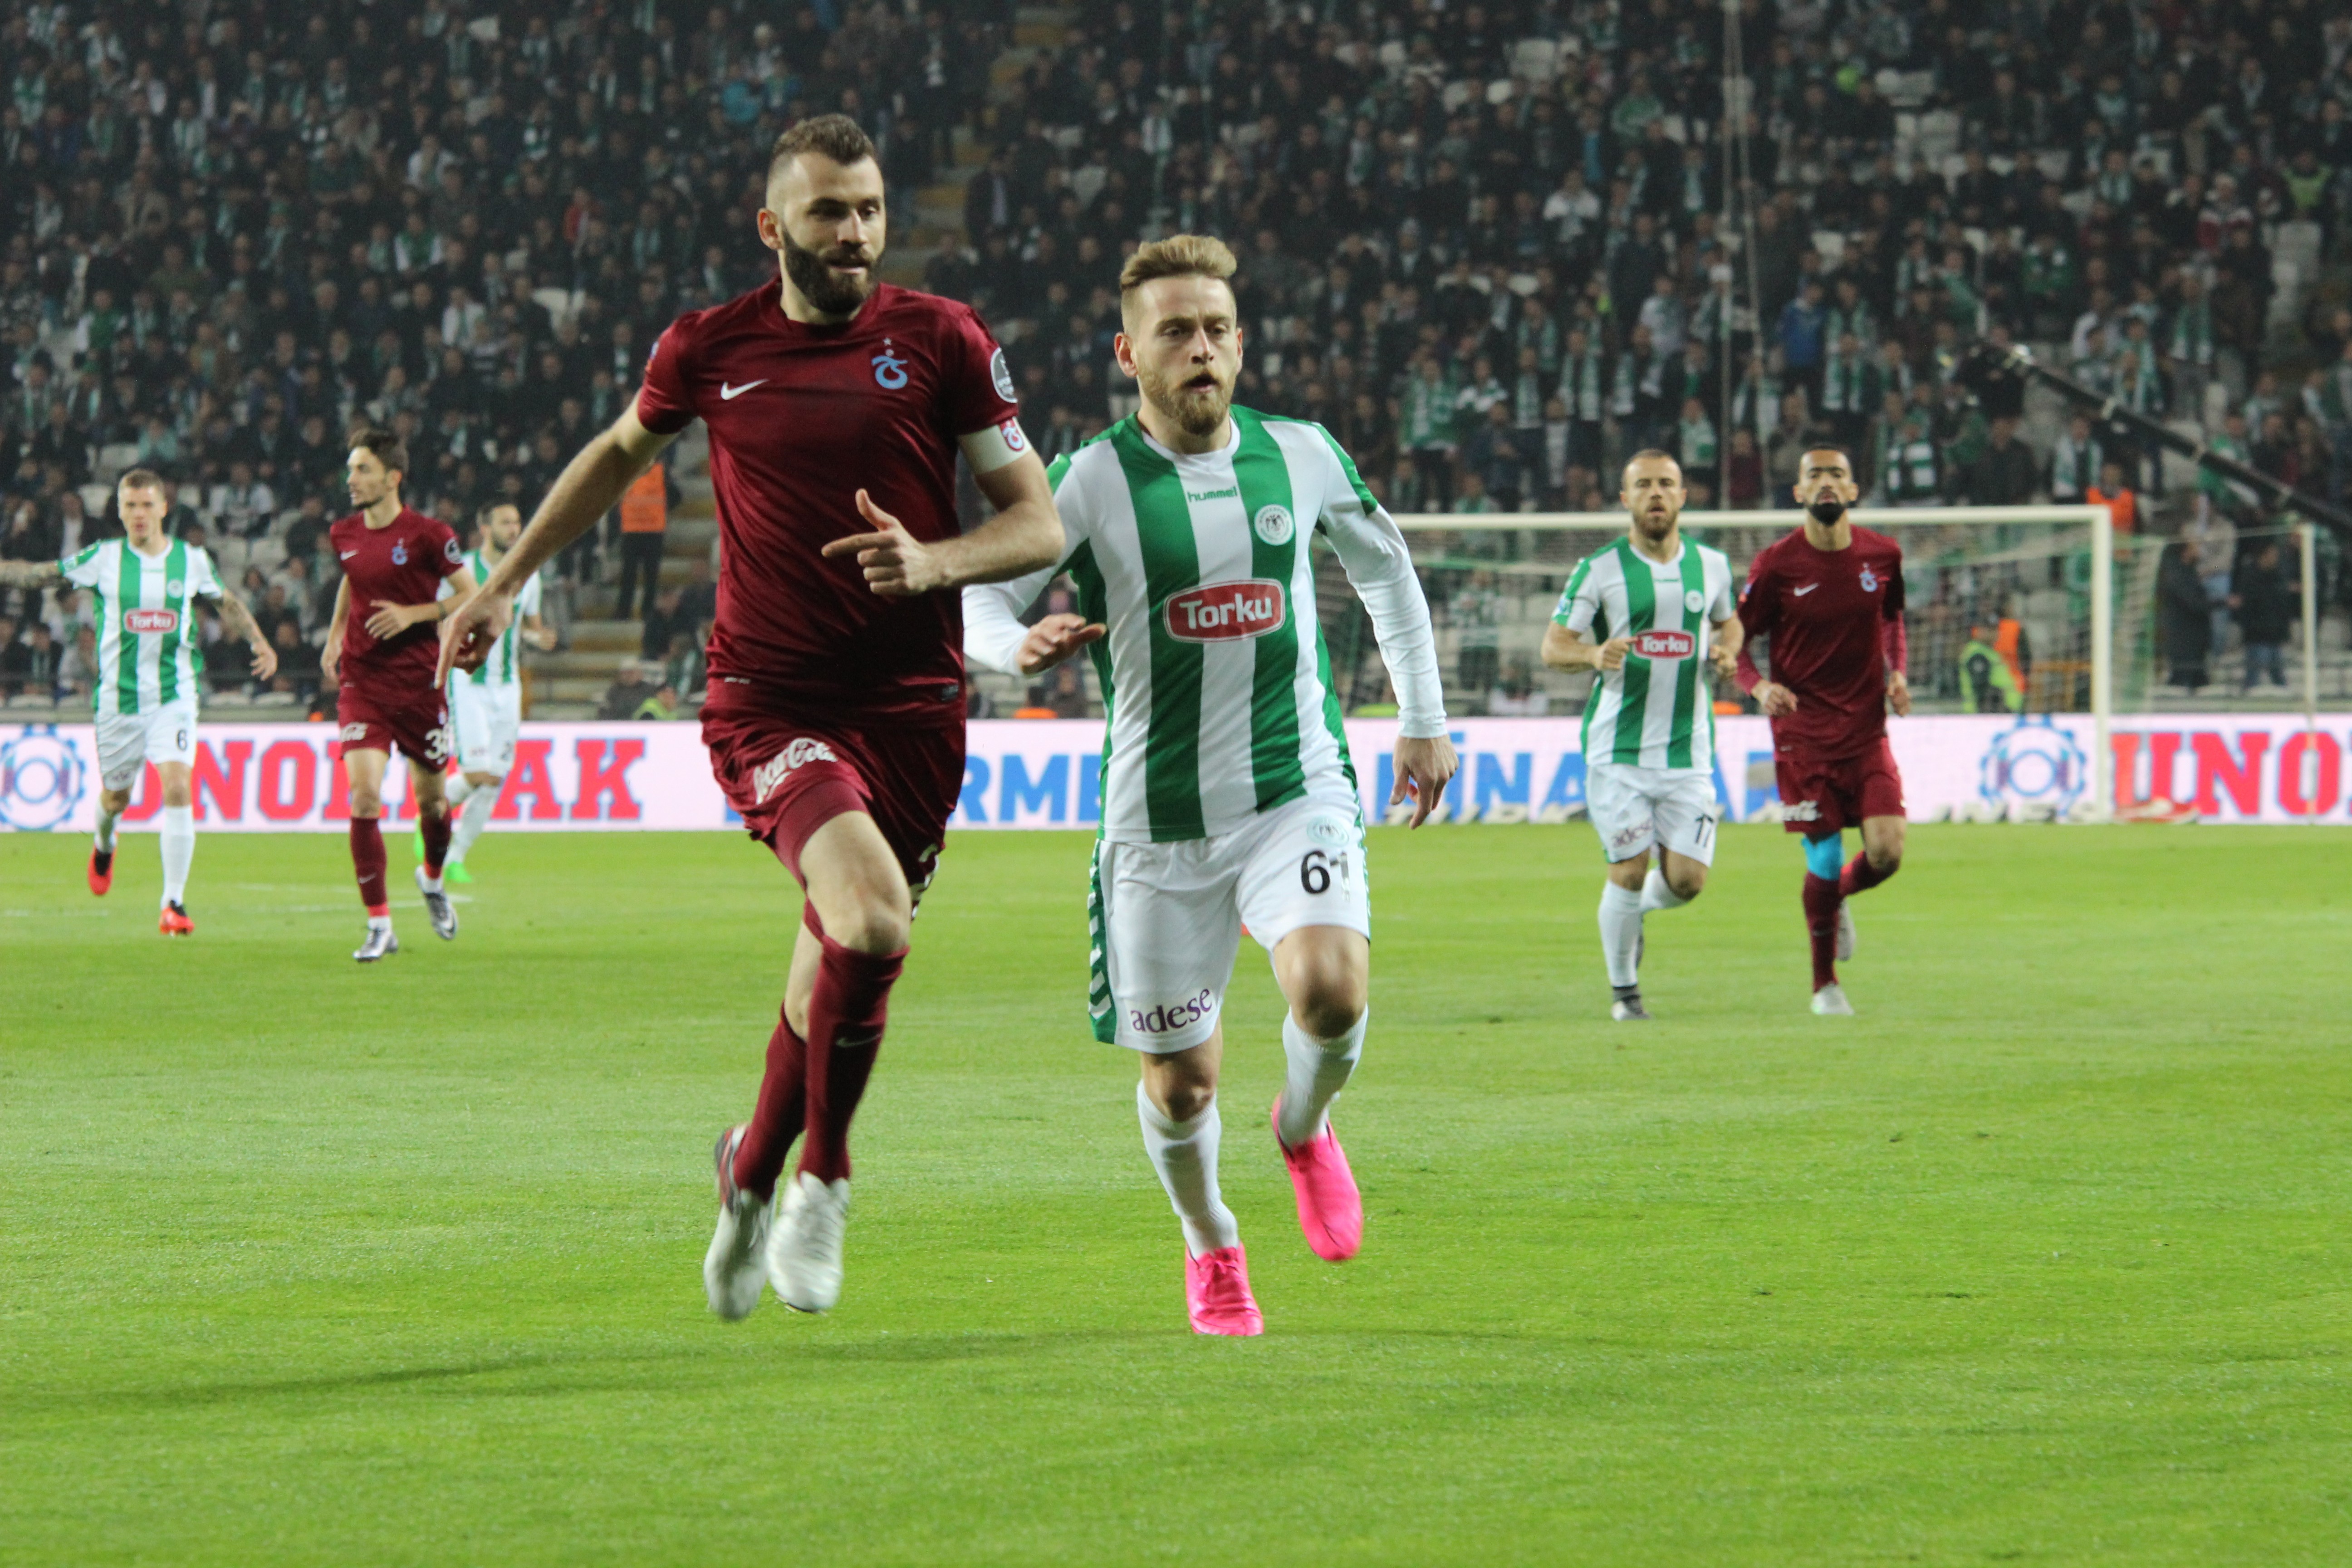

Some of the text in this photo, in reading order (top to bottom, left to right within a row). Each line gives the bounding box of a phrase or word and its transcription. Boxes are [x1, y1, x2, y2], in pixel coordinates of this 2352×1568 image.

[1187, 486, 1237, 502] hummel
[130, 612, 172, 628] Torku
[1179, 593, 1272, 629] Torku
[1641, 635, 1689, 653] Torku
[176, 729, 187, 750] 6
[2110, 731, 2352, 816] UNO
[1301, 850, 1350, 901] 61
[1130, 989, 1212, 1033] adese
